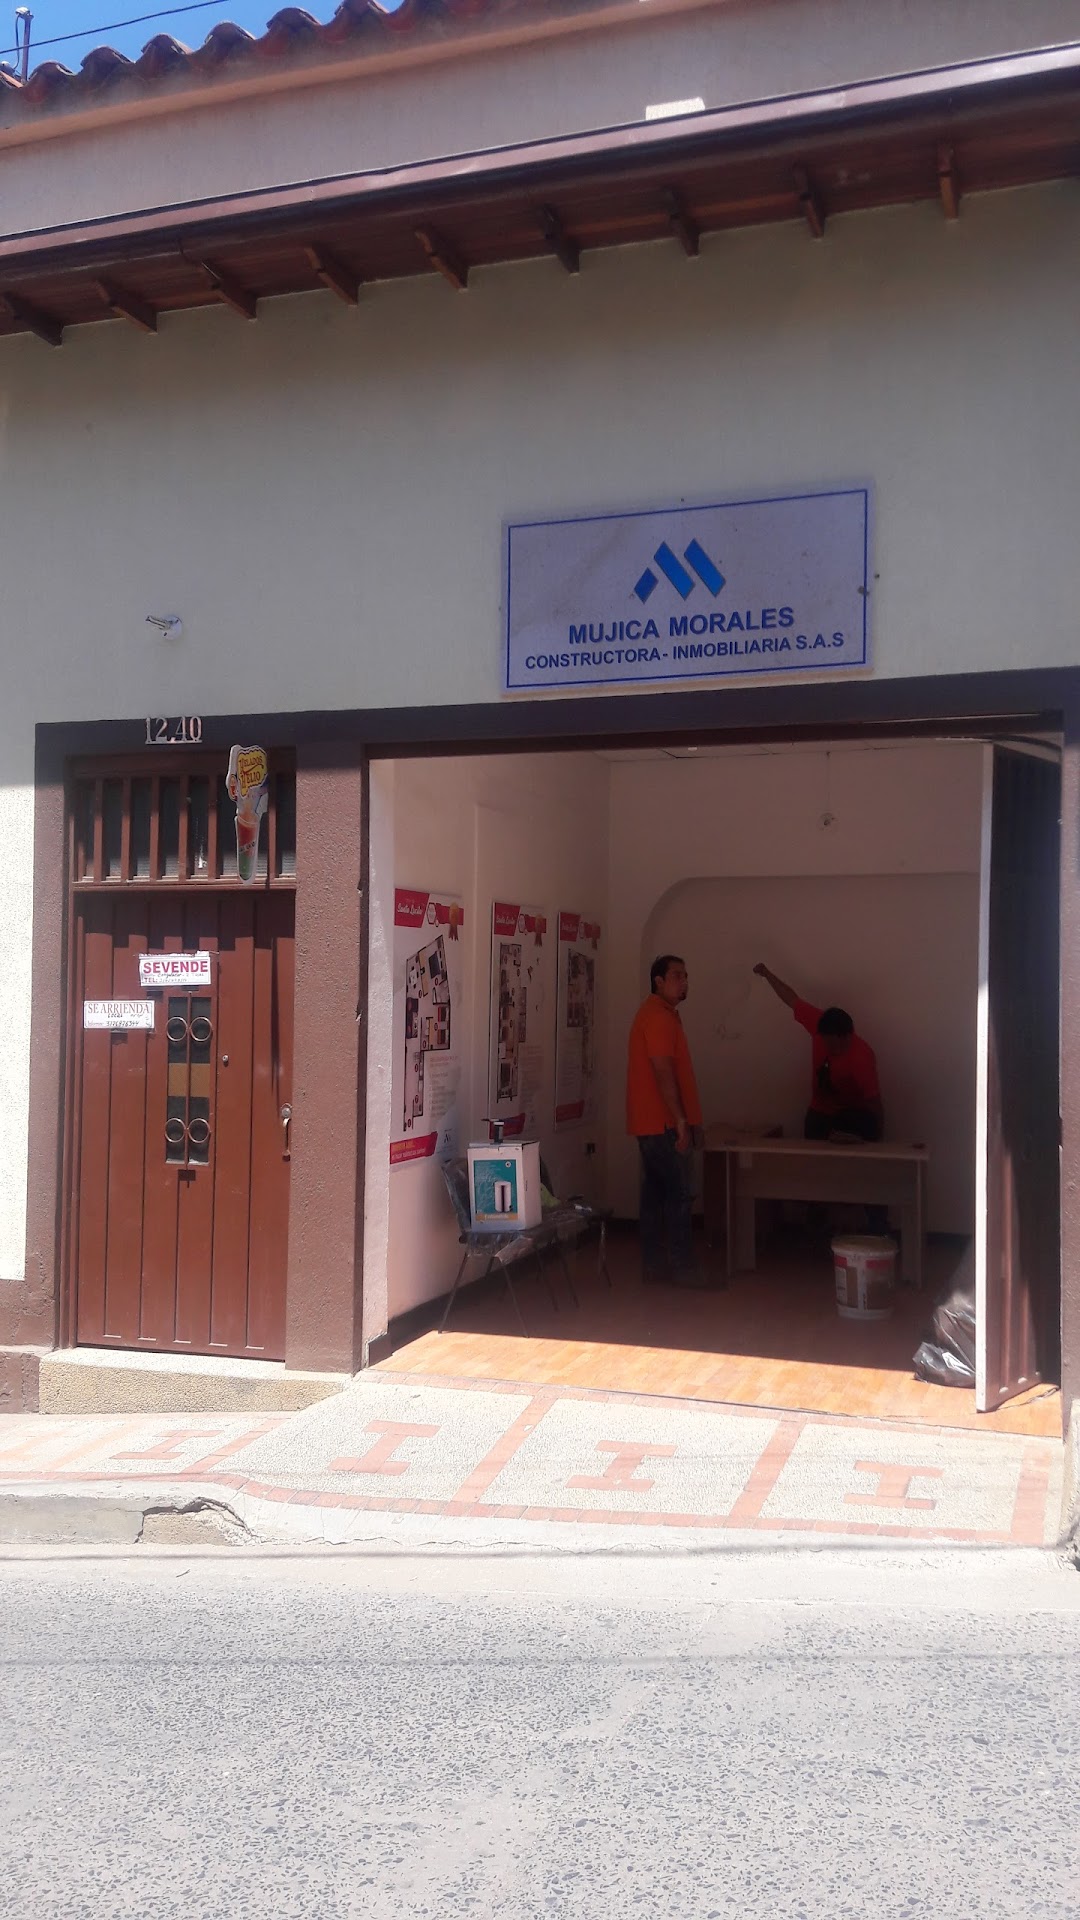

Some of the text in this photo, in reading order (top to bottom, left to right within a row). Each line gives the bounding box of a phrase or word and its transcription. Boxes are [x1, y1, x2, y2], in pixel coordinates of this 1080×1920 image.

[569, 607, 795, 644] MUJICA MORALES
[673, 636, 791, 660] INMOBILIARIA
[796, 632, 845, 650] S.A.S
[88, 1003, 150, 1014] SE ARRIENDA
